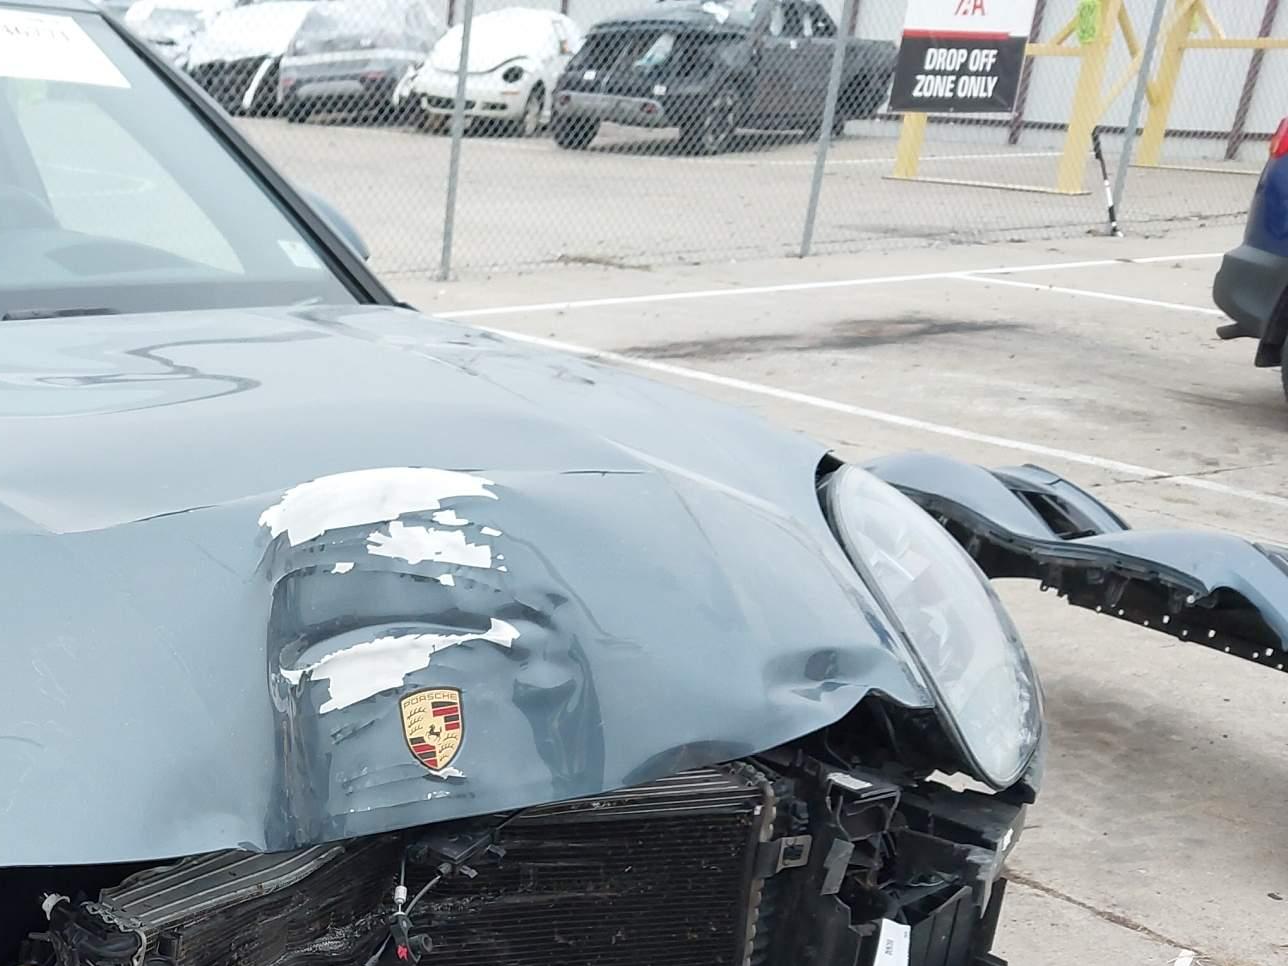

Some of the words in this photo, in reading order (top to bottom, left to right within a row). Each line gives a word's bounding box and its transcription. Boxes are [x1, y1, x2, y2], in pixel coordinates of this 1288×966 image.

[924, 48, 968, 71] DROP
[968, 49, 999, 72] OFF
[912, 74, 957, 98] ZONE
[957, 75, 999, 98] ONLY
[403, 692, 457, 709] PORSCHE
